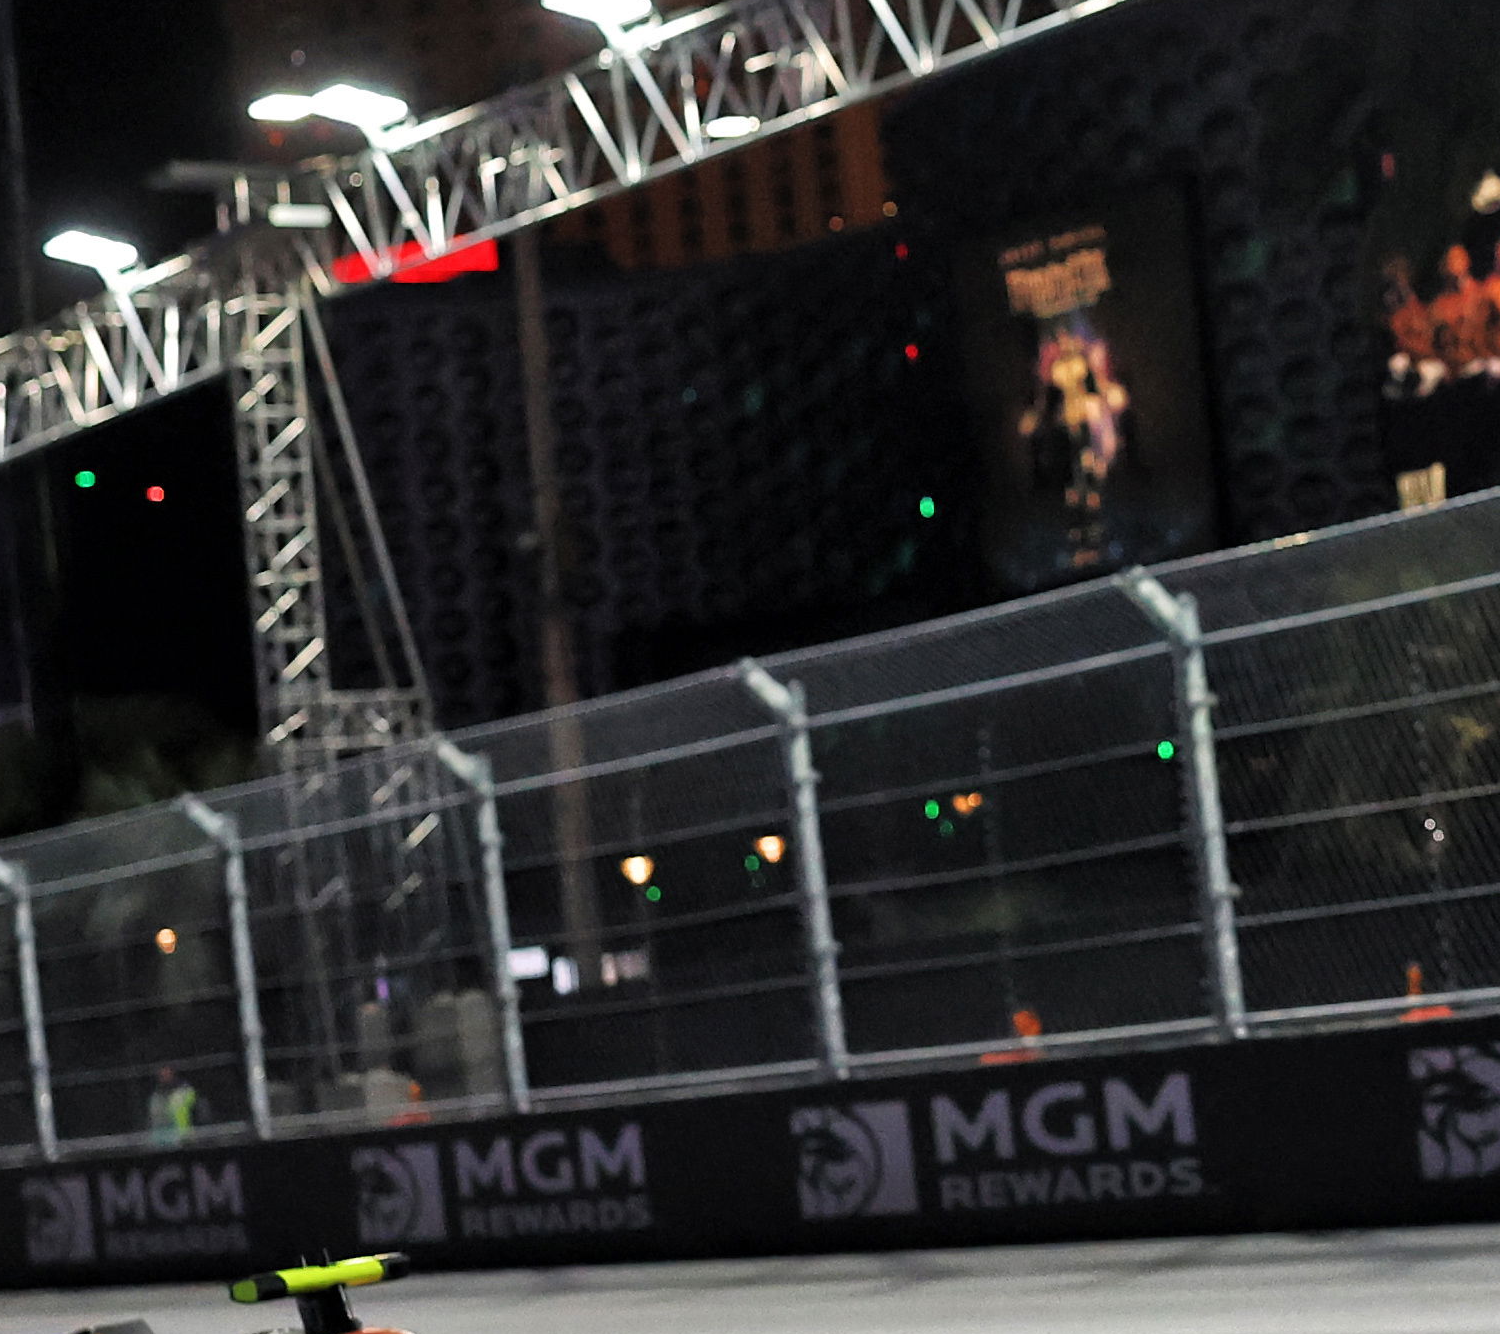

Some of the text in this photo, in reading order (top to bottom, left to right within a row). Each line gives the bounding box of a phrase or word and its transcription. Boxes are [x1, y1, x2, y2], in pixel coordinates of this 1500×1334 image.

[929, 1071, 1197, 1166] MGM
[100, 1163, 245, 1225] MGM
[454, 1122, 648, 1199] MGM
[940, 1158, 1203, 1212] REWARDS
